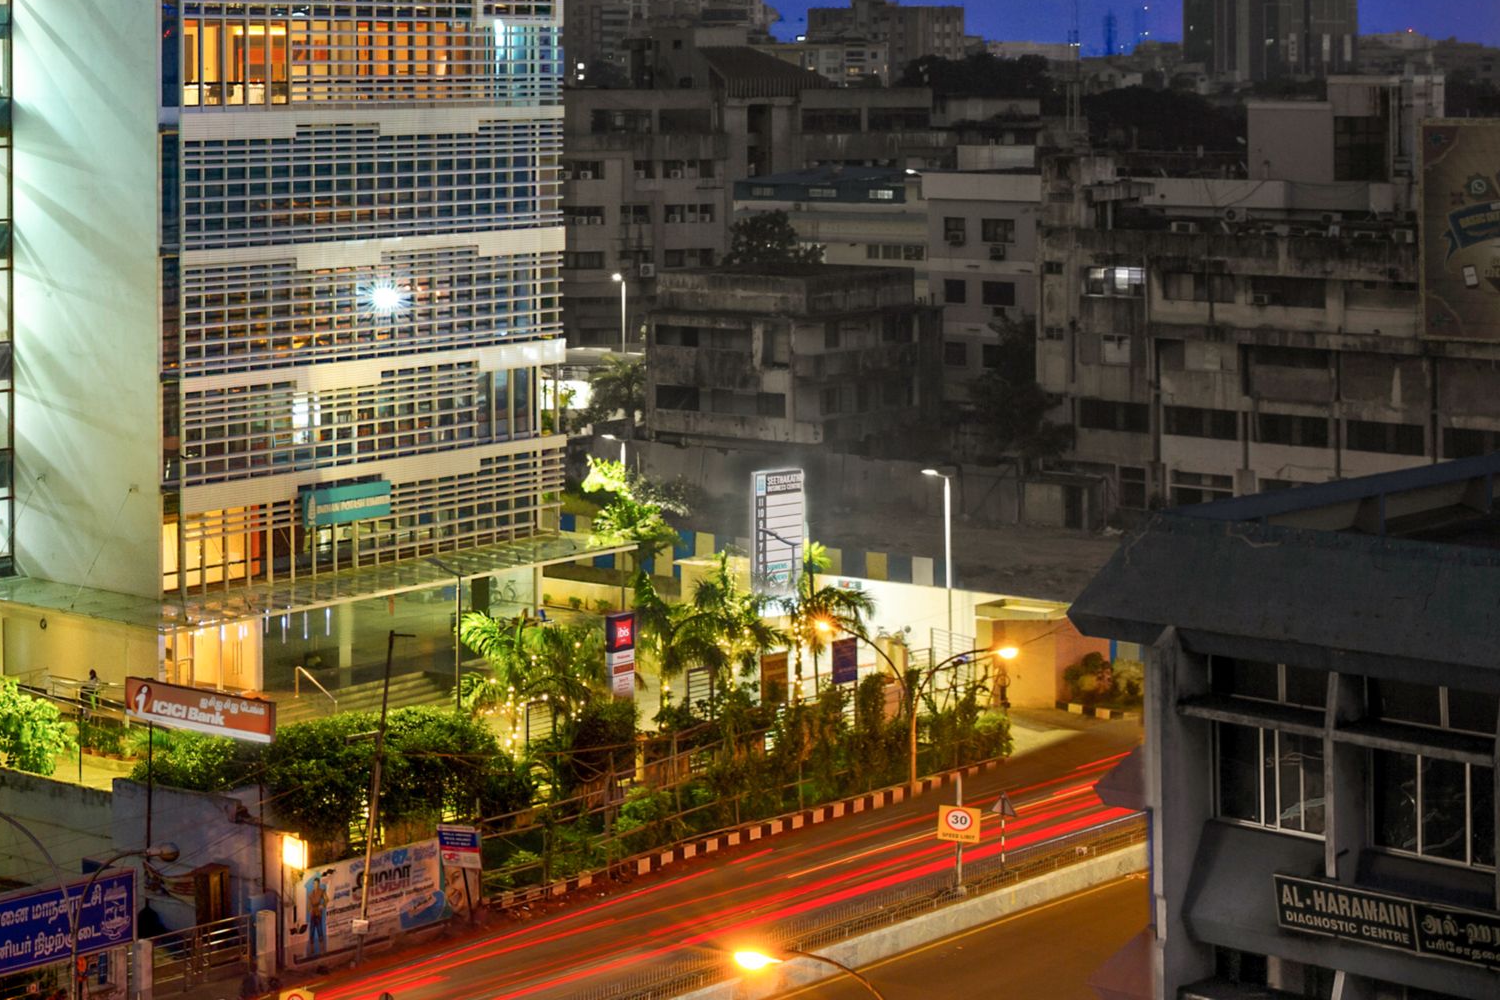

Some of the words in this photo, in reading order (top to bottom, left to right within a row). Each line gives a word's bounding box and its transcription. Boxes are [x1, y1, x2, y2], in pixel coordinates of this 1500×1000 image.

[152, 699, 187, 719] ICICI
[187, 706, 225, 726] Bank
[951, 814, 968, 826] 30
[1285, 910, 1358, 934] DIAGNOSTIC
[1361, 925, 1410, 944] CENTRE
